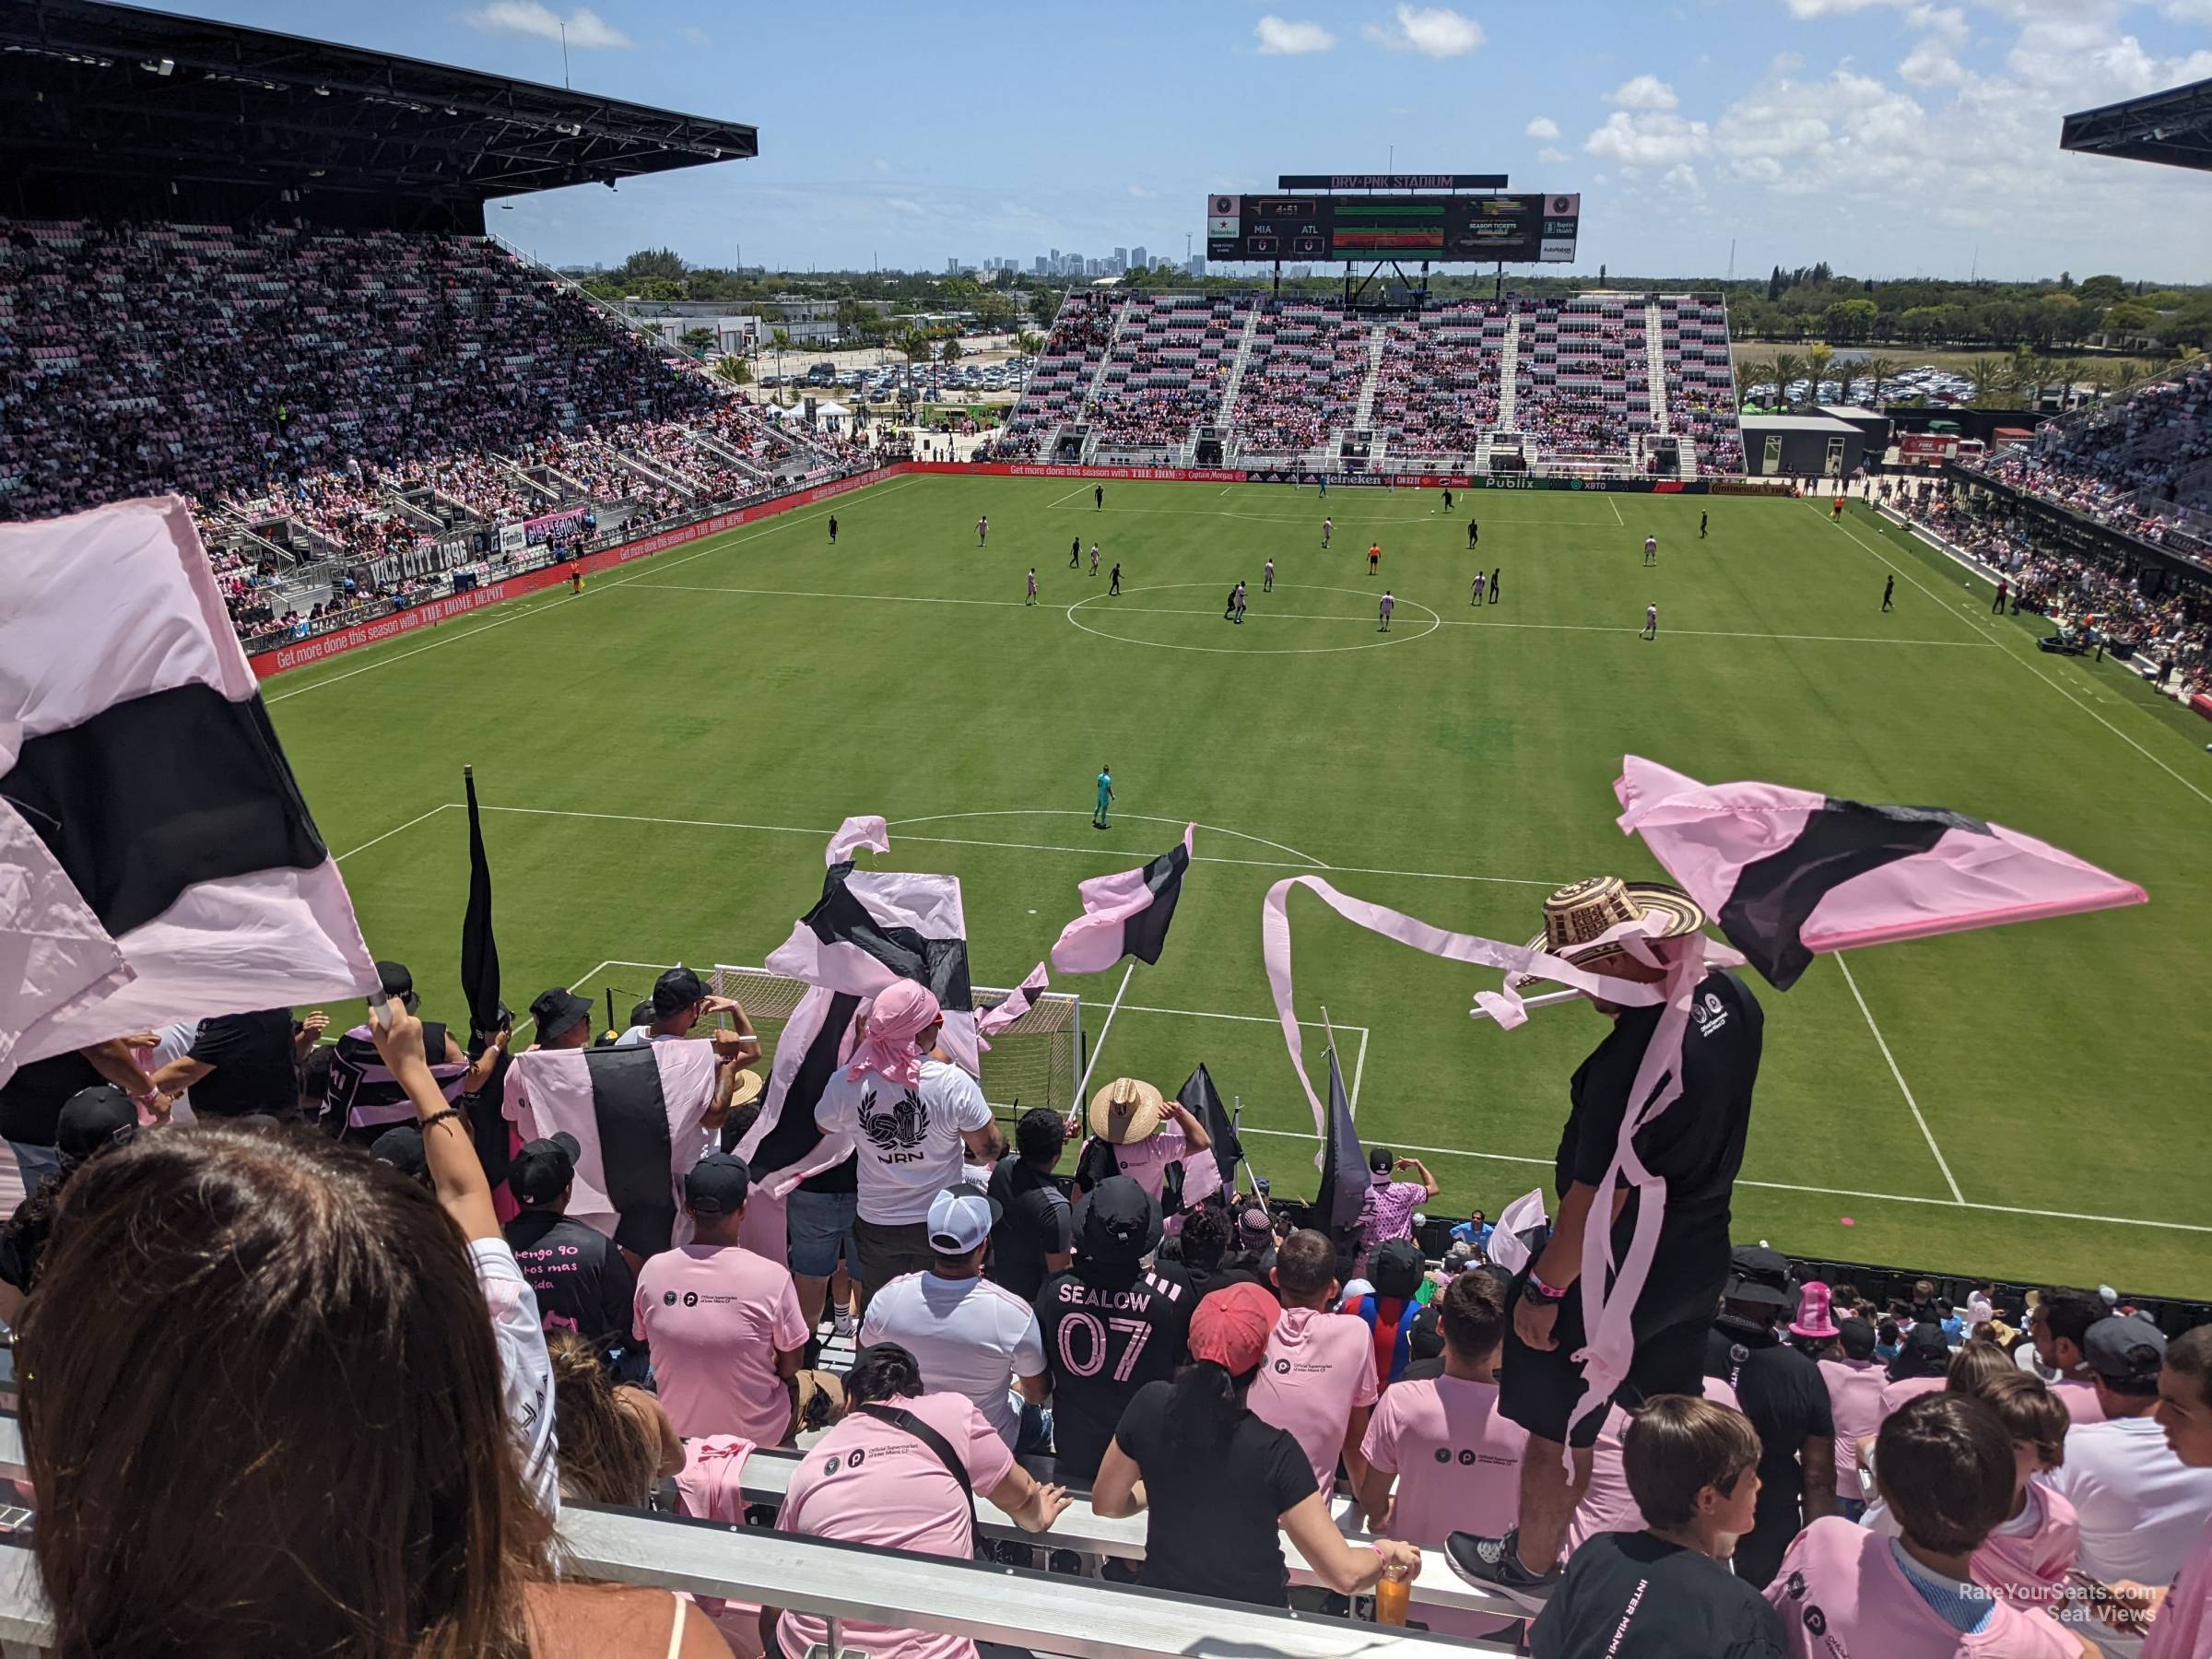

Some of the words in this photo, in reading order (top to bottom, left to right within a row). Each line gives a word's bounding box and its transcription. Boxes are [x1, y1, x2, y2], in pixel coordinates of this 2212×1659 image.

[1331, 176, 1358, 188] DRV
[1364, 176, 1388, 188] PNK
[1394, 176, 1453, 188] STADIUM
[1253, 225, 1272, 234] MIA
[1301, 225, 1318, 234] ATL
[1046, 466, 1065, 476] done
[1082, 468, 1110, 477] season
[1112, 468, 1128, 477] with
[1131, 468, 1152, 478] THE
[1486, 477, 1534, 488] Publix
[1584, 482, 1606, 490] XBTO
[1712, 483, 1760, 494] Continental
[619, 549, 630, 560] Get
[657, 536, 667, 548] this
[371, 555, 401, 588] VICE
[402, 547, 433, 577] CITY
[437, 539, 468, 570] 1896
[277, 652, 295, 668] Get
[297, 645, 323, 664] more
[324, 637, 348, 654] done
[348, 629, 367, 645] this
[369, 619, 399, 640] season
[400, 612, 418, 629] with
[420, 604, 442, 623] THE
[444, 594, 474, 616] HOME
[474, 585, 504, 606] DEPOT
[877, 1151, 925, 1165] NRN
[547, 1262, 577, 1273] mas
[1058, 1283, 1151, 1312] SEALOW
[1057, 1312, 1152, 1382] 07
[868, 1445, 886, 1453] Official
[1626, 1578, 1648, 1615] INTER
[1607, 1617, 1630, 1653] MIAMI
